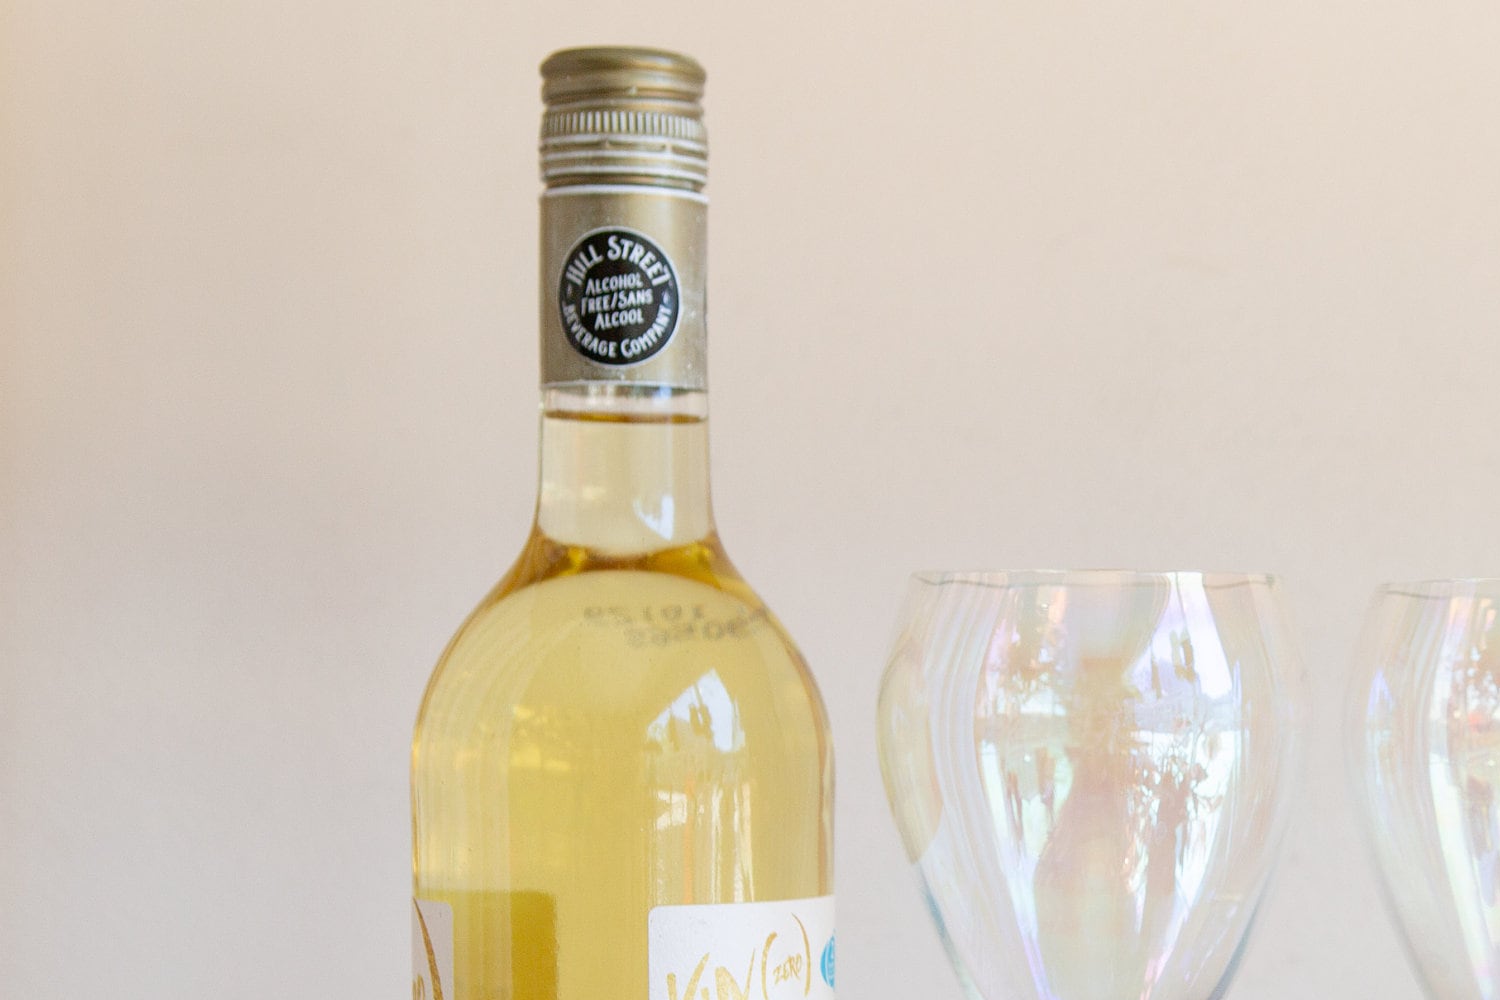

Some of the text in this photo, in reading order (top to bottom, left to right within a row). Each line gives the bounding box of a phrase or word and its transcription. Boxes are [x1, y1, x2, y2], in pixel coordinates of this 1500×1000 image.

[566, 235, 672, 286] HILL STREET
[586, 272, 643, 295] ALCOHOL
[581, 289, 653, 315] FREE/SANS
[562, 302, 672, 358] BEVERAGE COMPANY
[595, 308, 644, 330] ALCOOL
